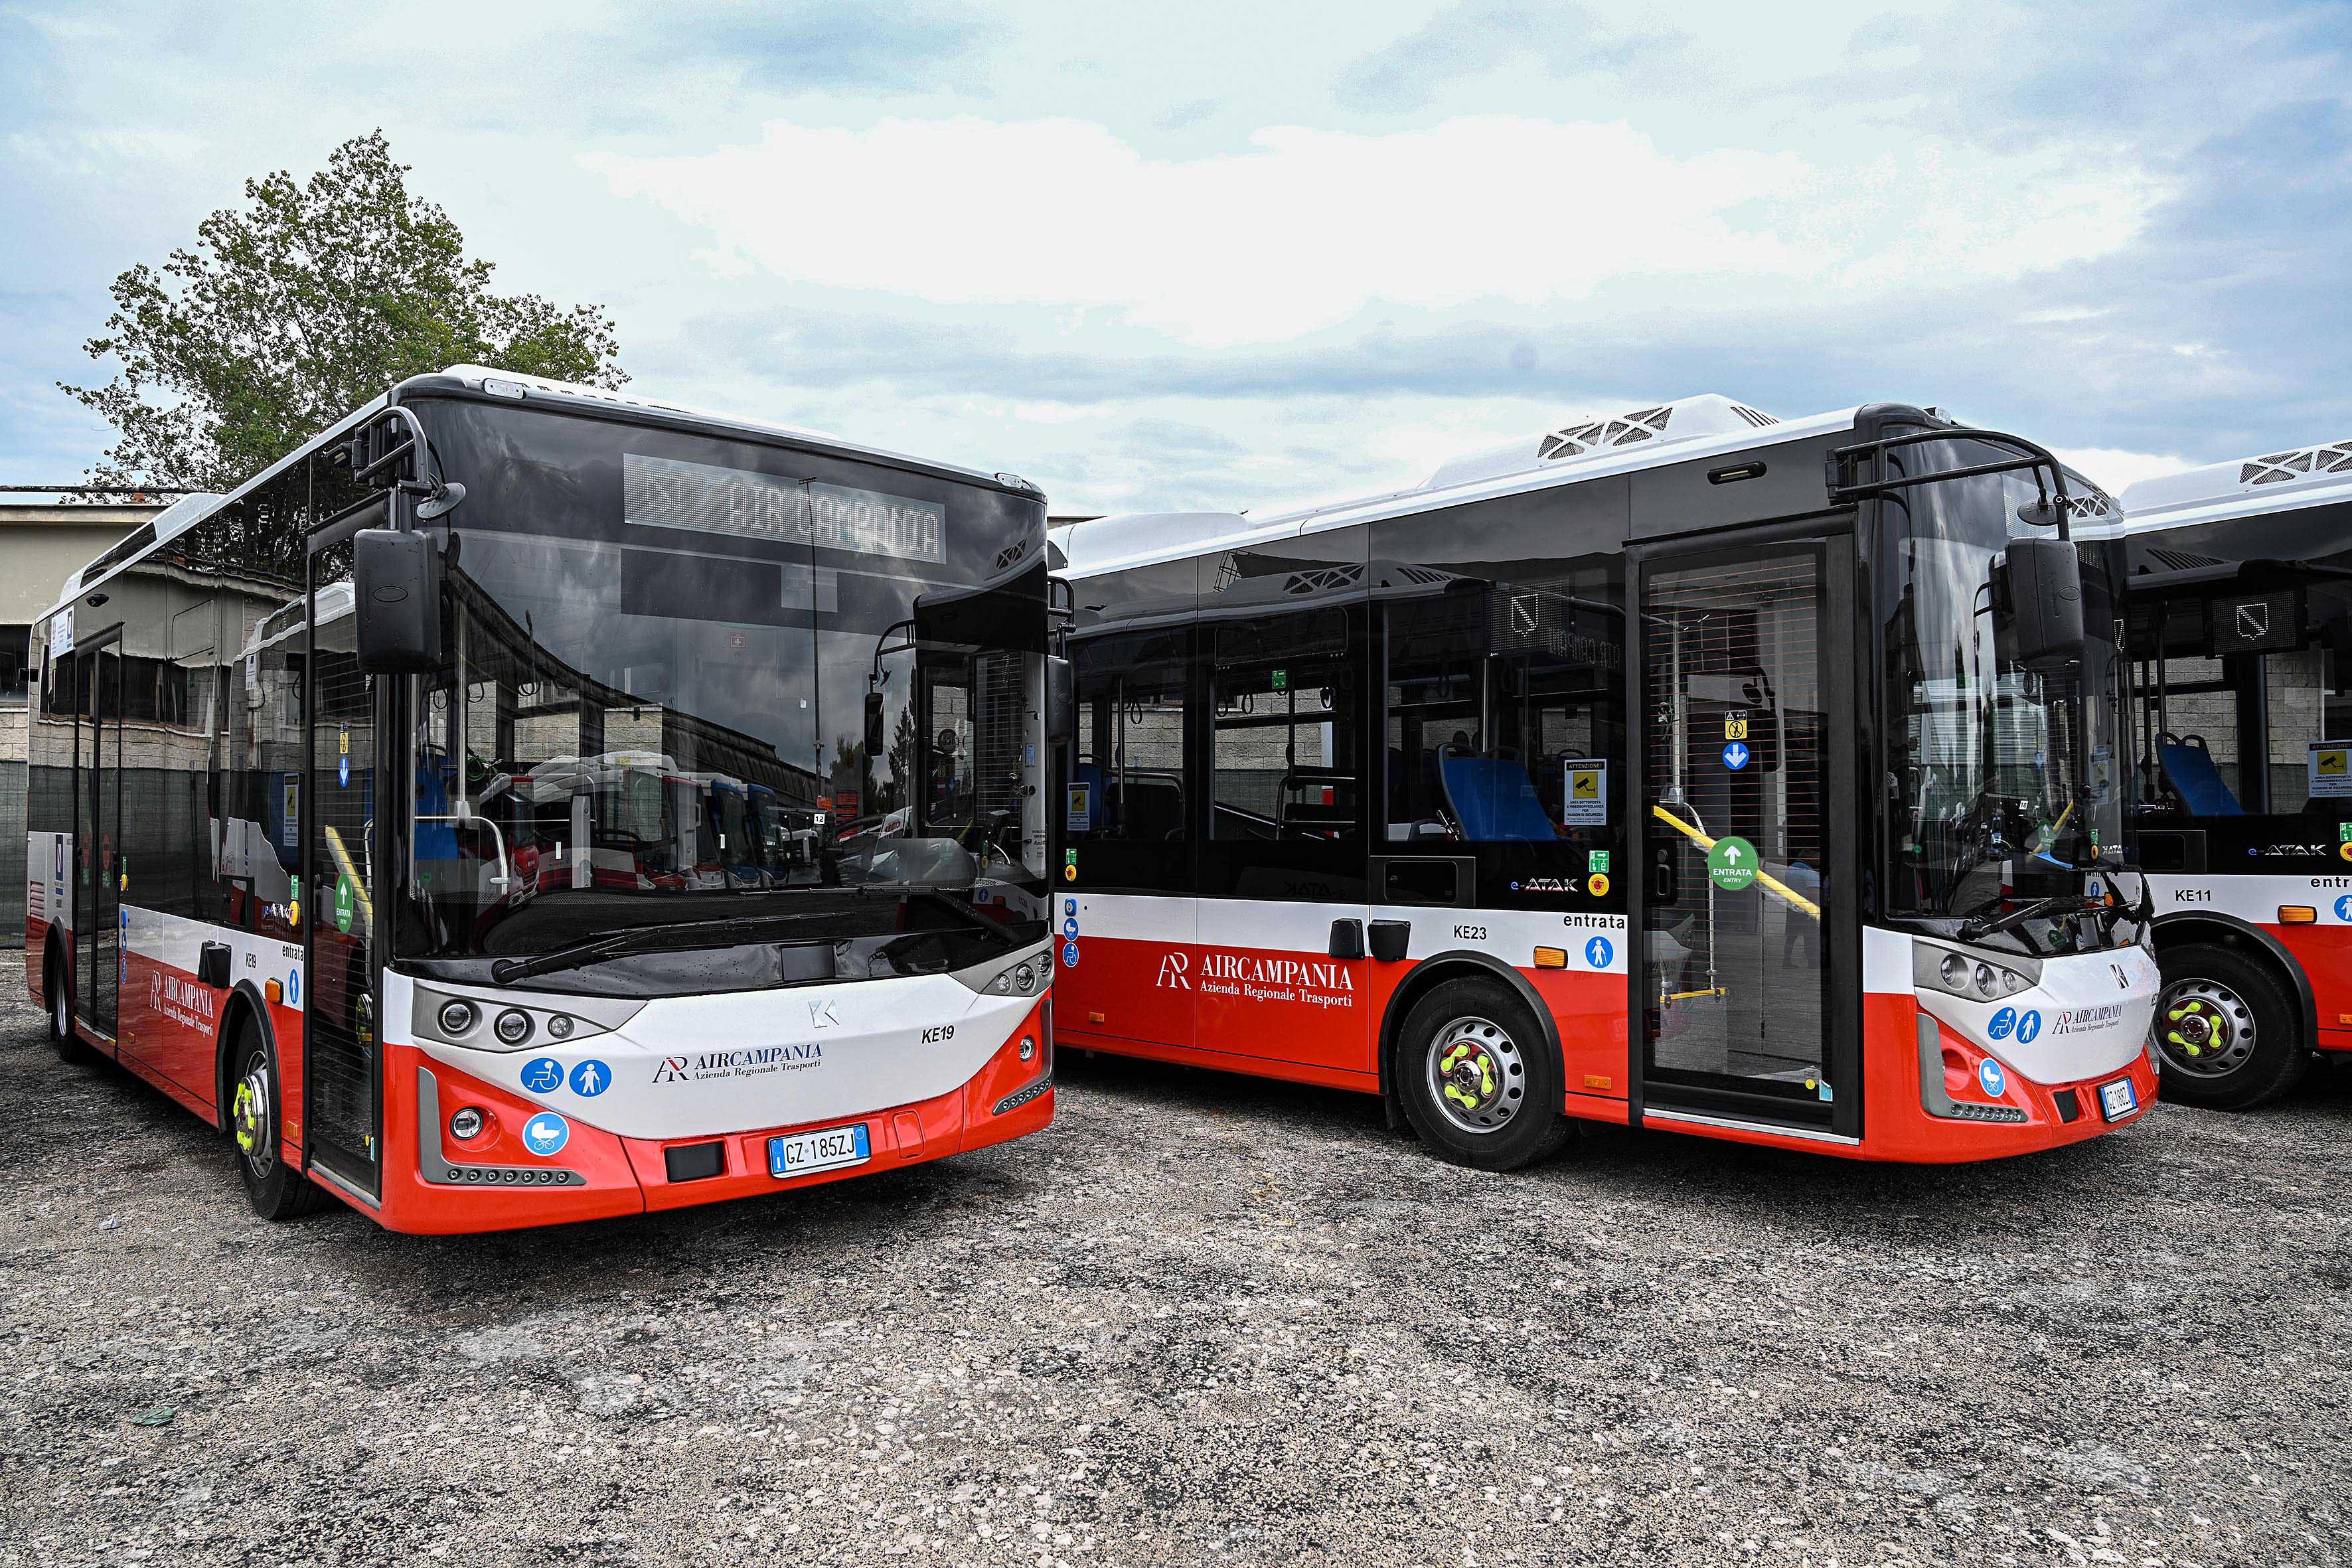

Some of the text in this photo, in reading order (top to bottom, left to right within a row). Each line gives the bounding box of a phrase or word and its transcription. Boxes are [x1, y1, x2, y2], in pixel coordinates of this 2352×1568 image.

[730, 482, 939, 555] AIR CAMPANIA
[1511, 878, 1578, 892] e-ATAK
[2175, 890, 2211, 902] KE11
[337, 907, 351, 918] ENTRATA
[1563, 914, 1625, 929] entrata
[1453, 925, 1487, 940] KE23
[246, 952, 257, 969] KE19
[282, 945, 303, 961] entrata
[1200, 954, 1354, 990] AIRCAMPANIA
[163, 973, 214, 1018] AIRCAMPANIA
[1200, 979, 1353, 1009] Azienda Regionale Trasporti
[2073, 1004, 2122, 1024] AIRCAMPANIA
[921, 1024, 955, 1044] KE19
[694, 1043, 823, 1070] AIRCAMPANIA
[693, 1059, 821, 1080] Azienda Regionale Trasporti
